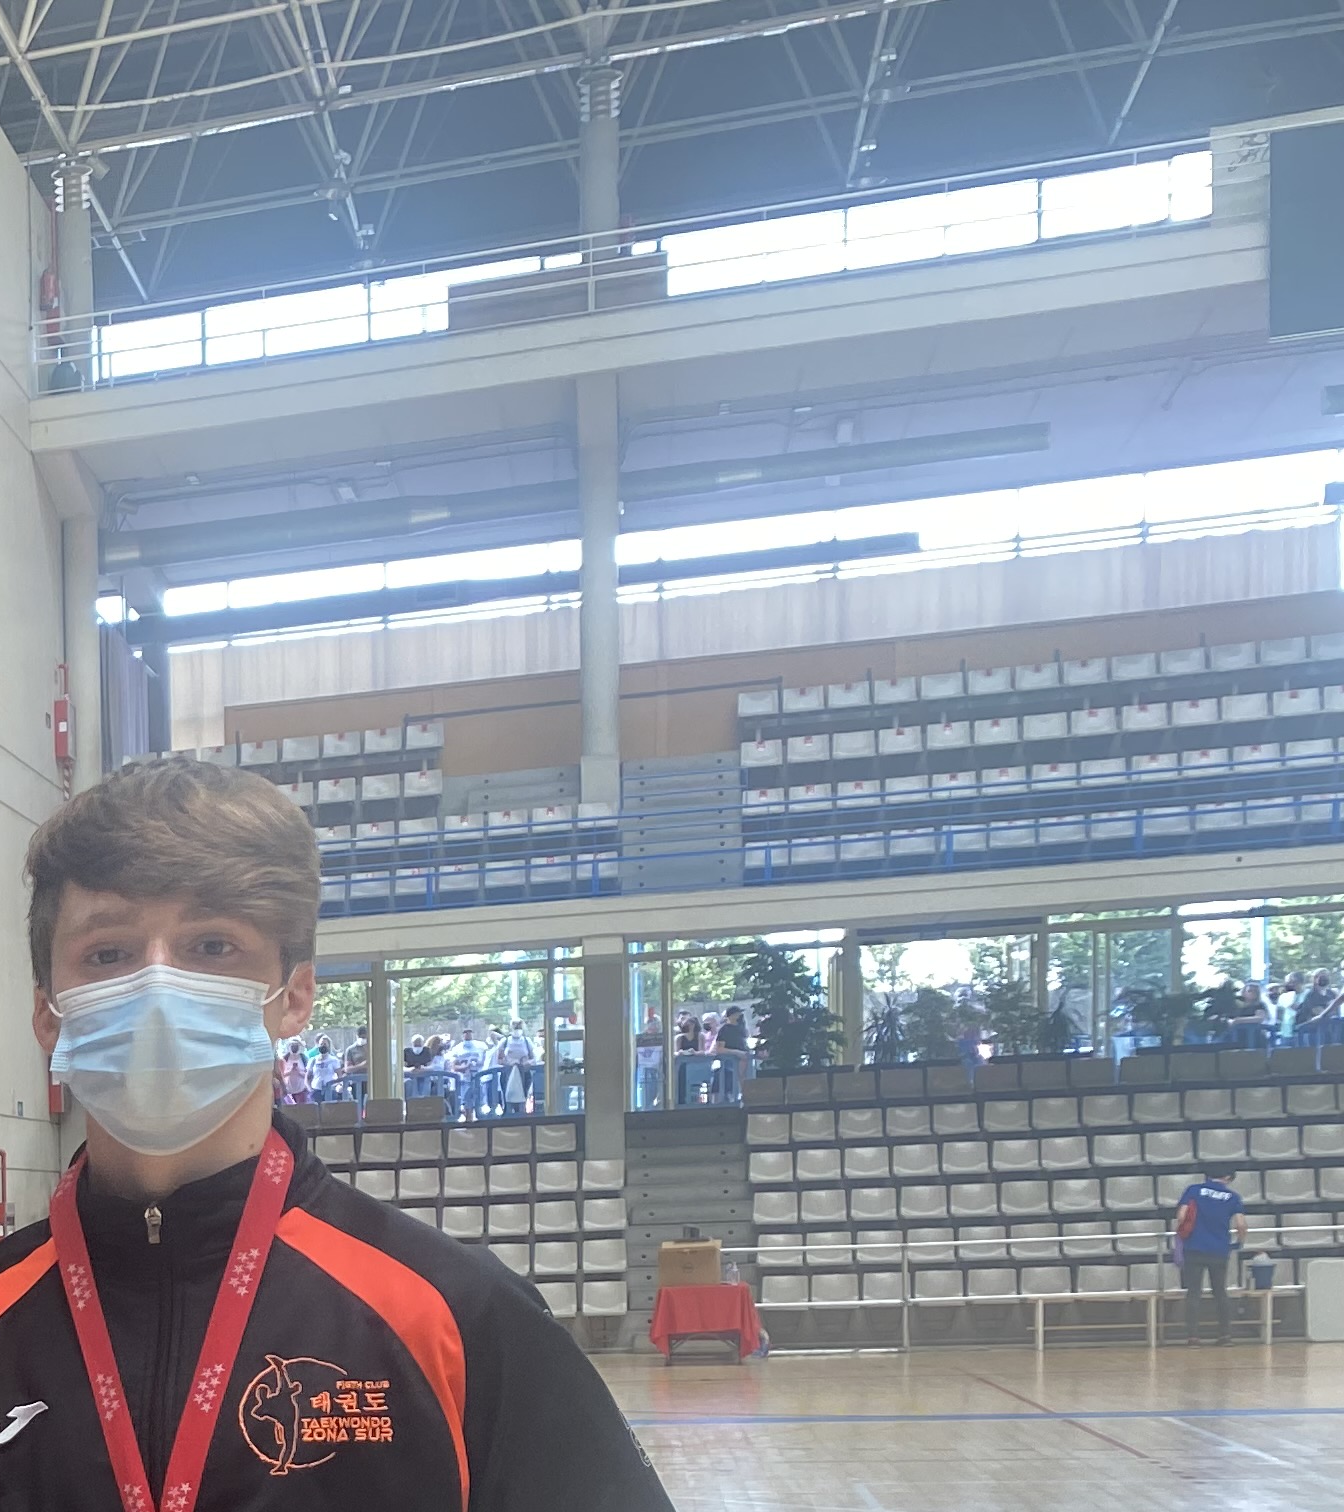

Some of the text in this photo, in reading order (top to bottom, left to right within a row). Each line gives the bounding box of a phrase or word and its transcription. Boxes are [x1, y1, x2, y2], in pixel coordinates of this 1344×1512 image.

[365, 1380, 391, 1389] CLUB
[301, 1416, 392, 1430] TAEKWONDO
[301, 1427, 394, 1442] ZONA SUR
